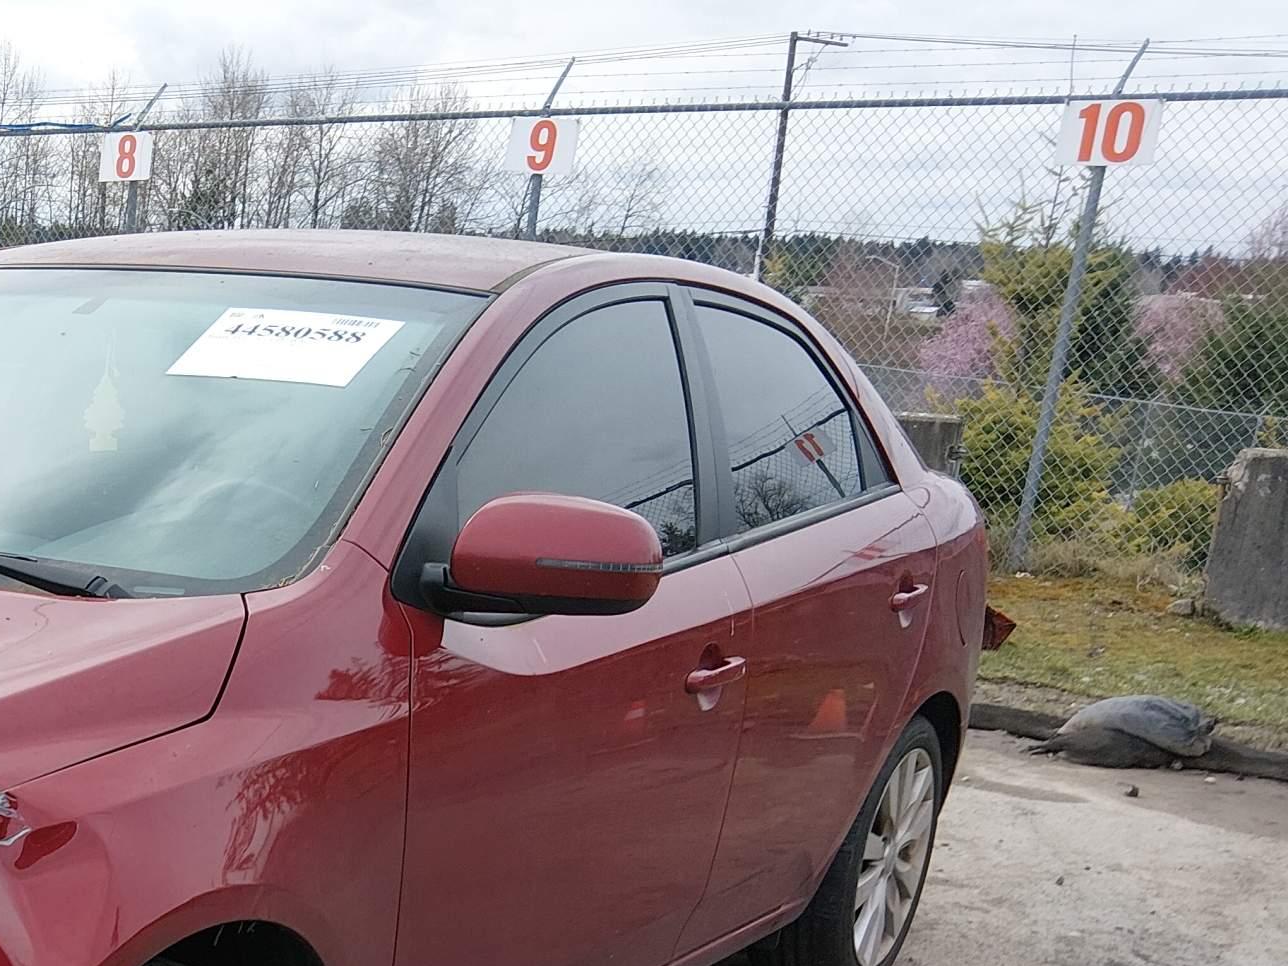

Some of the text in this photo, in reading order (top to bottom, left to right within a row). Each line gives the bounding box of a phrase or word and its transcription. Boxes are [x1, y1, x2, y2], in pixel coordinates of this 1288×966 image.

[527, 120, 557, 171] 9
[1077, 102, 1145, 163] 10
[116, 135, 137, 179] 8
[224, 322, 367, 344] 44580588
